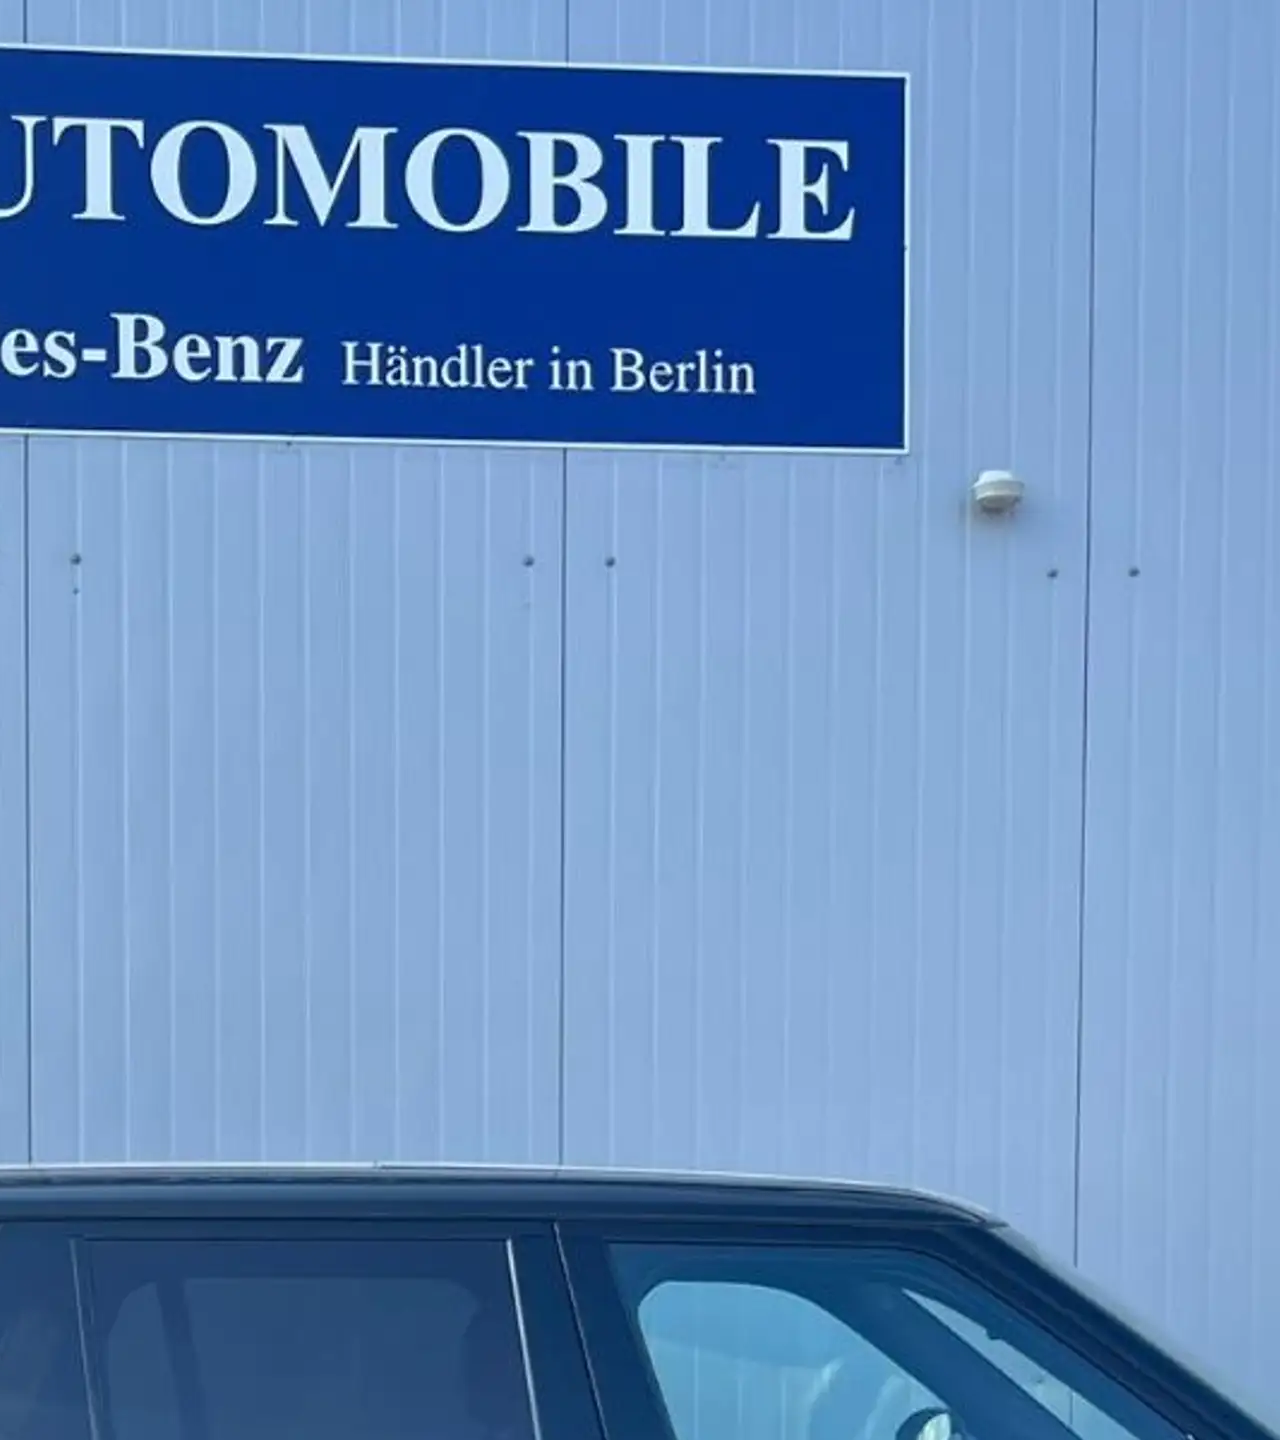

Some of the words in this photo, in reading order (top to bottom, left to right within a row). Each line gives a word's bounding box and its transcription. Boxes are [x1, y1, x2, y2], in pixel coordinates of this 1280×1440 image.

[341, 341, 534, 390] Händler
[550, 345, 593, 391] in
[610, 347, 756, 394] Berlin
